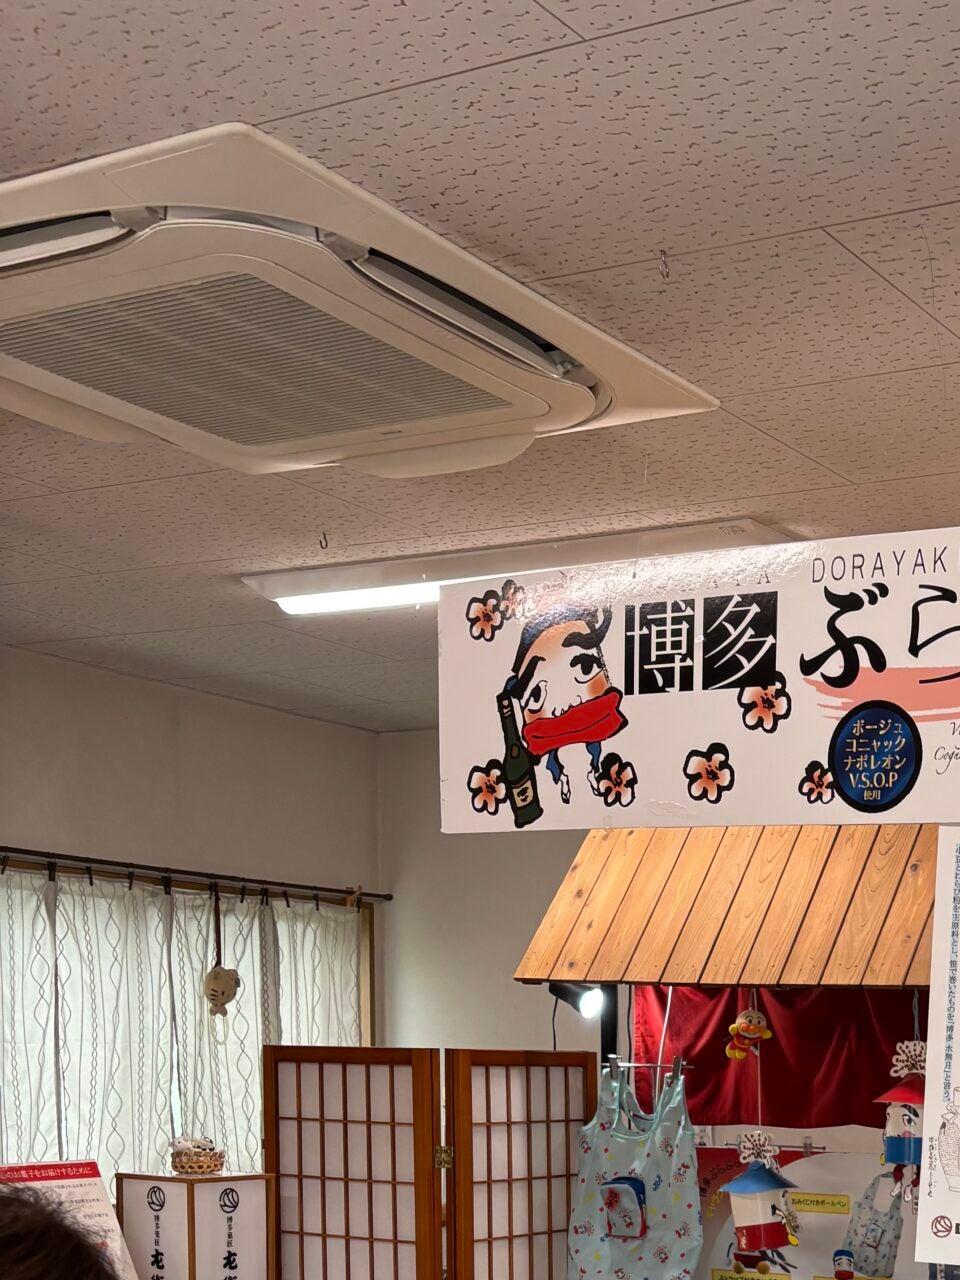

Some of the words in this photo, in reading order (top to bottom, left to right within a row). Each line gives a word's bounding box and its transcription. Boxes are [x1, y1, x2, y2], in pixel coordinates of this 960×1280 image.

[622, 592, 778, 695] 博多
[845, 736, 907, 753] コニャック
[843, 754, 907, 771] ナポレオン
[849, 772, 898, 789] V.S.O.P
